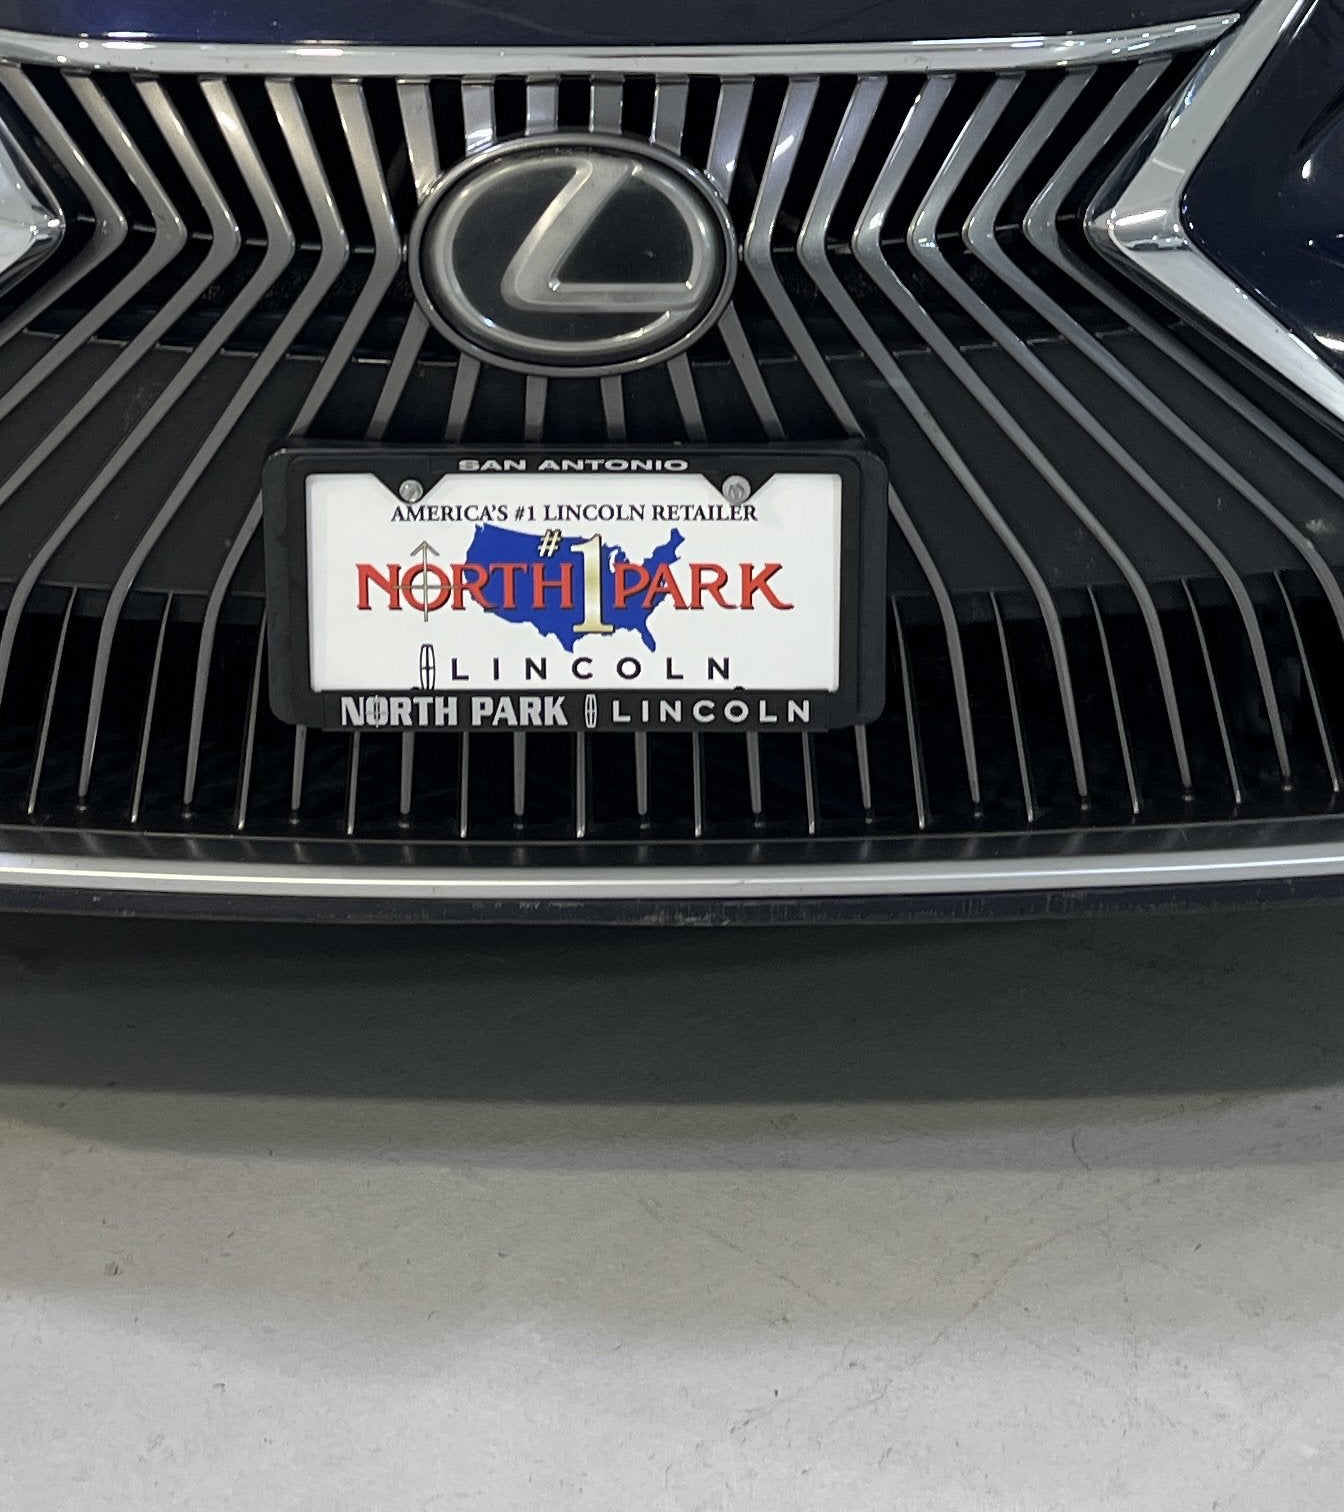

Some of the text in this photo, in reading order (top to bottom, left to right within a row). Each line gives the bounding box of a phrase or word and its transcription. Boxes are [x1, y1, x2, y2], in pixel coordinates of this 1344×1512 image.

[458, 458, 689, 472] SAN ANTONIO
[391, 503, 759, 522] AMERICA'S #1 LINCOLN RETAILER
[355, 562, 795, 611] NORTH PARK
[450, 656, 731, 681] LINCOLN
[340, 695, 811, 727] NORTH PARK LINCOLN
